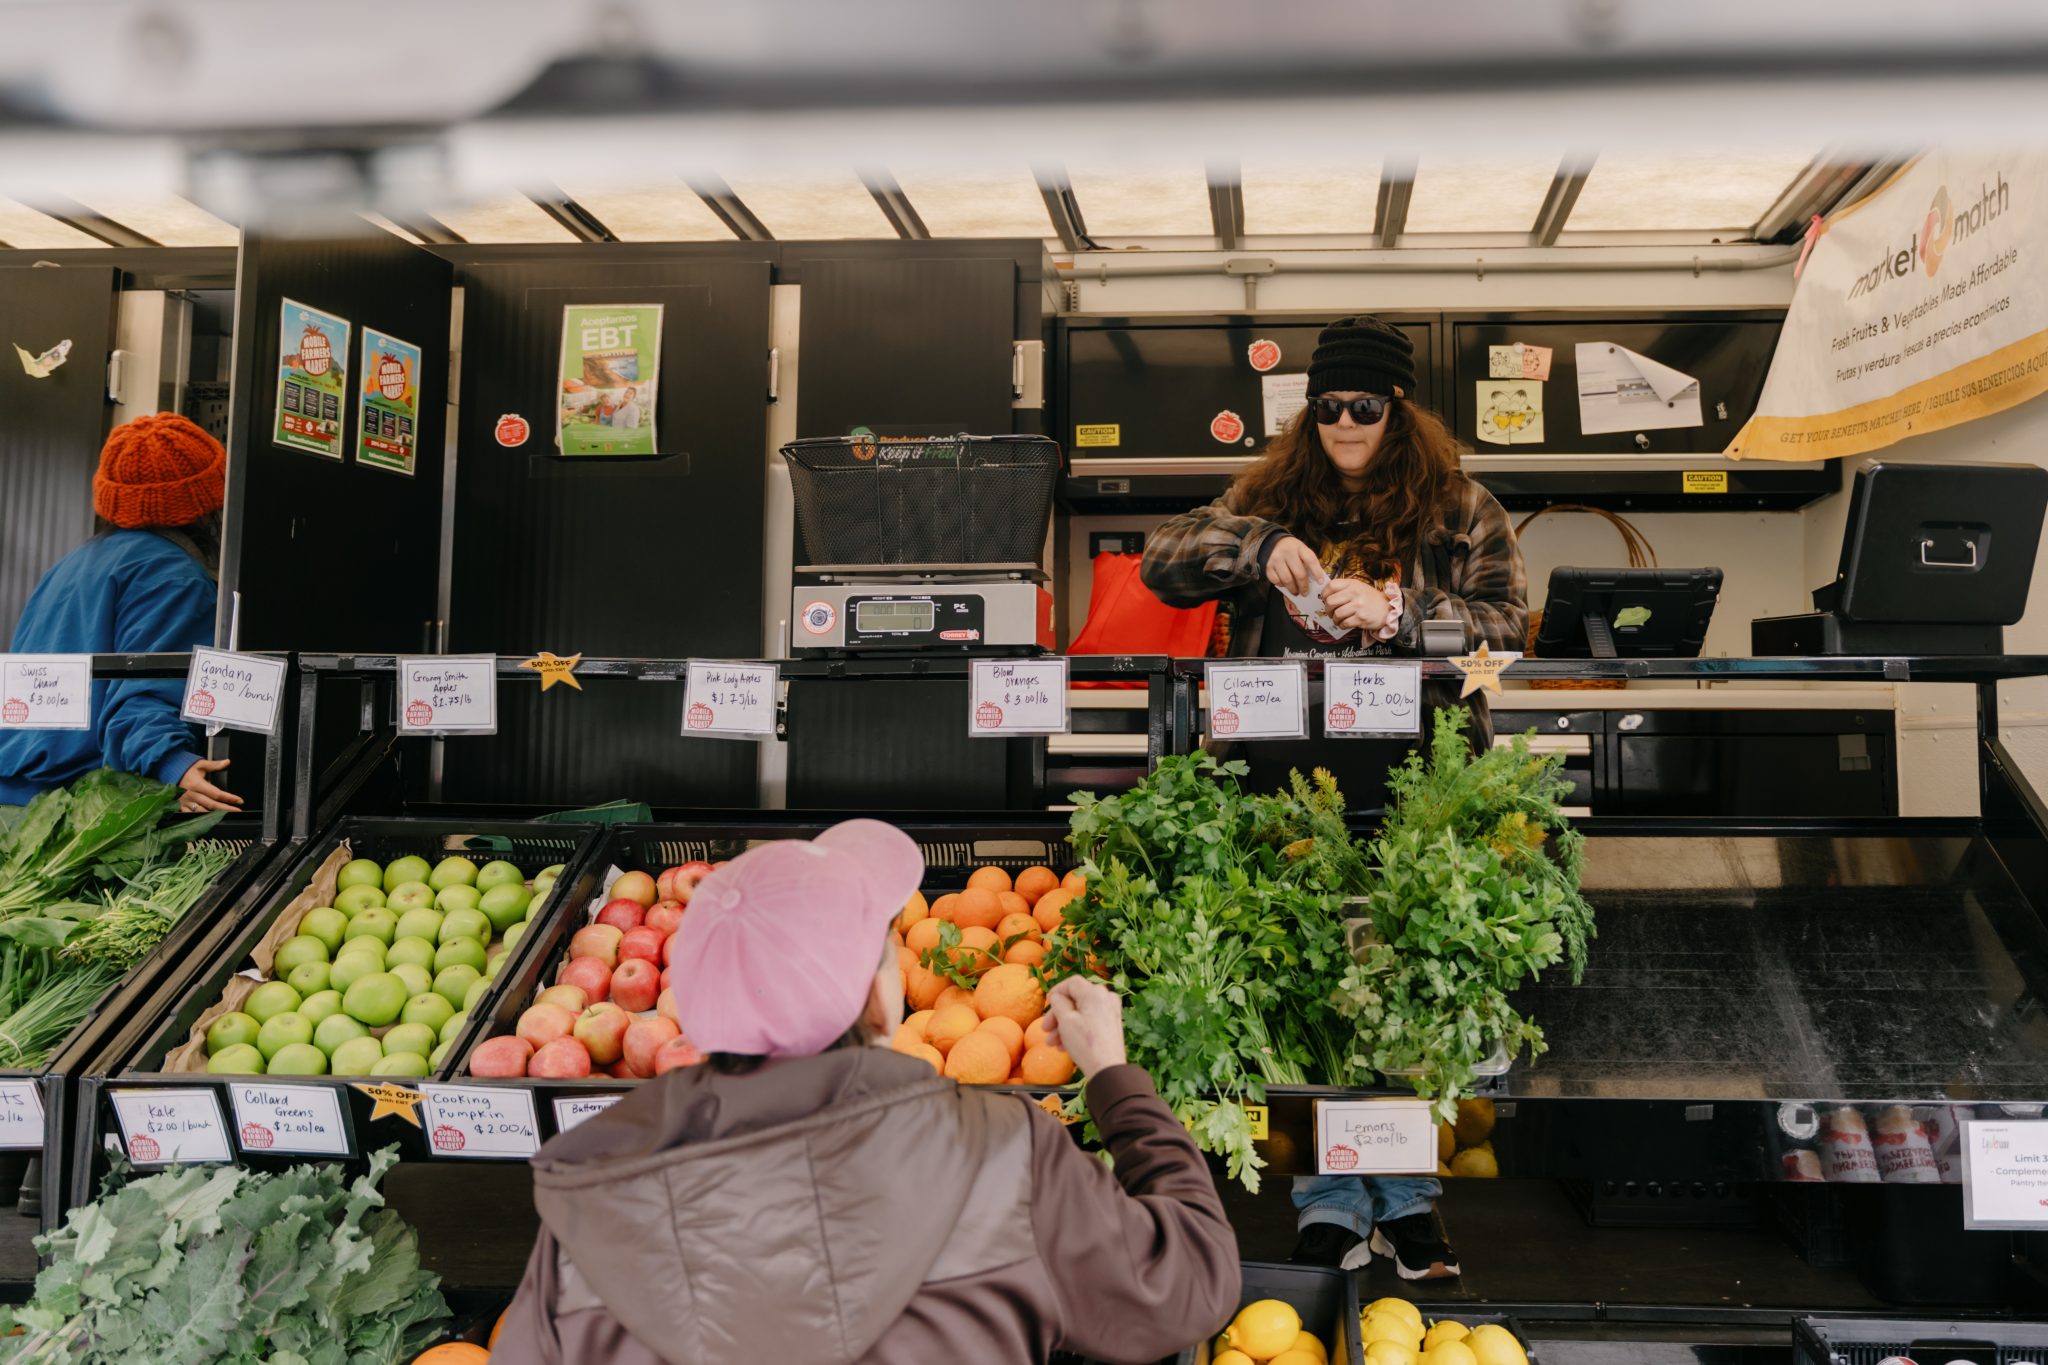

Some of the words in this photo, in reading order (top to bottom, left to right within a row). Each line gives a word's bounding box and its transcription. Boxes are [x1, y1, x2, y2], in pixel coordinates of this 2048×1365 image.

[1952, 170, 2009, 246] match
[1848, 233, 1918, 301] market
[1831, 331, 1850, 354] Fresh
[1852, 322, 1878, 344] Fruits
[1881, 316, 1890, 334] &
[1894, 294, 1939, 331] Vegetables
[1940, 276, 1967, 304] Made
[1969, 244, 2018, 290] Affordable
[580, 315, 638, 327] Aceptamos
[581, 325, 638, 351] EBT
[301, 347, 330, 361] FARMERS
[1836, 368, 1857, 384] Frutas
[1864, 353, 1902, 373] verdura
[1932, 321, 1962, 350] precios
[1780, 432, 1805, 443] GET
[1806, 429, 1830, 443] YOUR
[1830, 420, 1869, 439] BENEFITS
[1902, 401, 1923, 419] HERE
[1928, 389, 1961, 411] IGUALE
[1961, 382, 1978, 400] SUS
[1978, 361, 2026, 394] BENEFICIOS
[21, 664, 47, 676] Swiss
[201, 660, 252, 682] Gandana
[413, 670, 441, 684] Granny
[444, 670, 469, 682] Smith
[33, 676, 60, 690] Chard
[706, 671, 721, 683] Pink
[724, 672, 738, 688] Lady
[740, 672, 761, 684] Apples
[1223, 677, 1274, 690] Cilantro
[1353, 670, 1386, 686] Herbs
[433, 684, 458, 693] Apples
[0, 1090, 24, 1105] ts
[245, 1089, 289, 1105] Collard
[368, 1088, 392, 1096] 50%
[396, 1091, 420, 1100] OFF
[432, 1093, 491, 1109] Cooking
[147, 1104, 176, 1118] Kale
[275, 1107, 314, 1118] Greens
[438, 1108, 504, 1120] Pumpkin
[1345, 1119, 1395, 1134] Lemons
[2014, 1154, 2040, 1163] Limit
